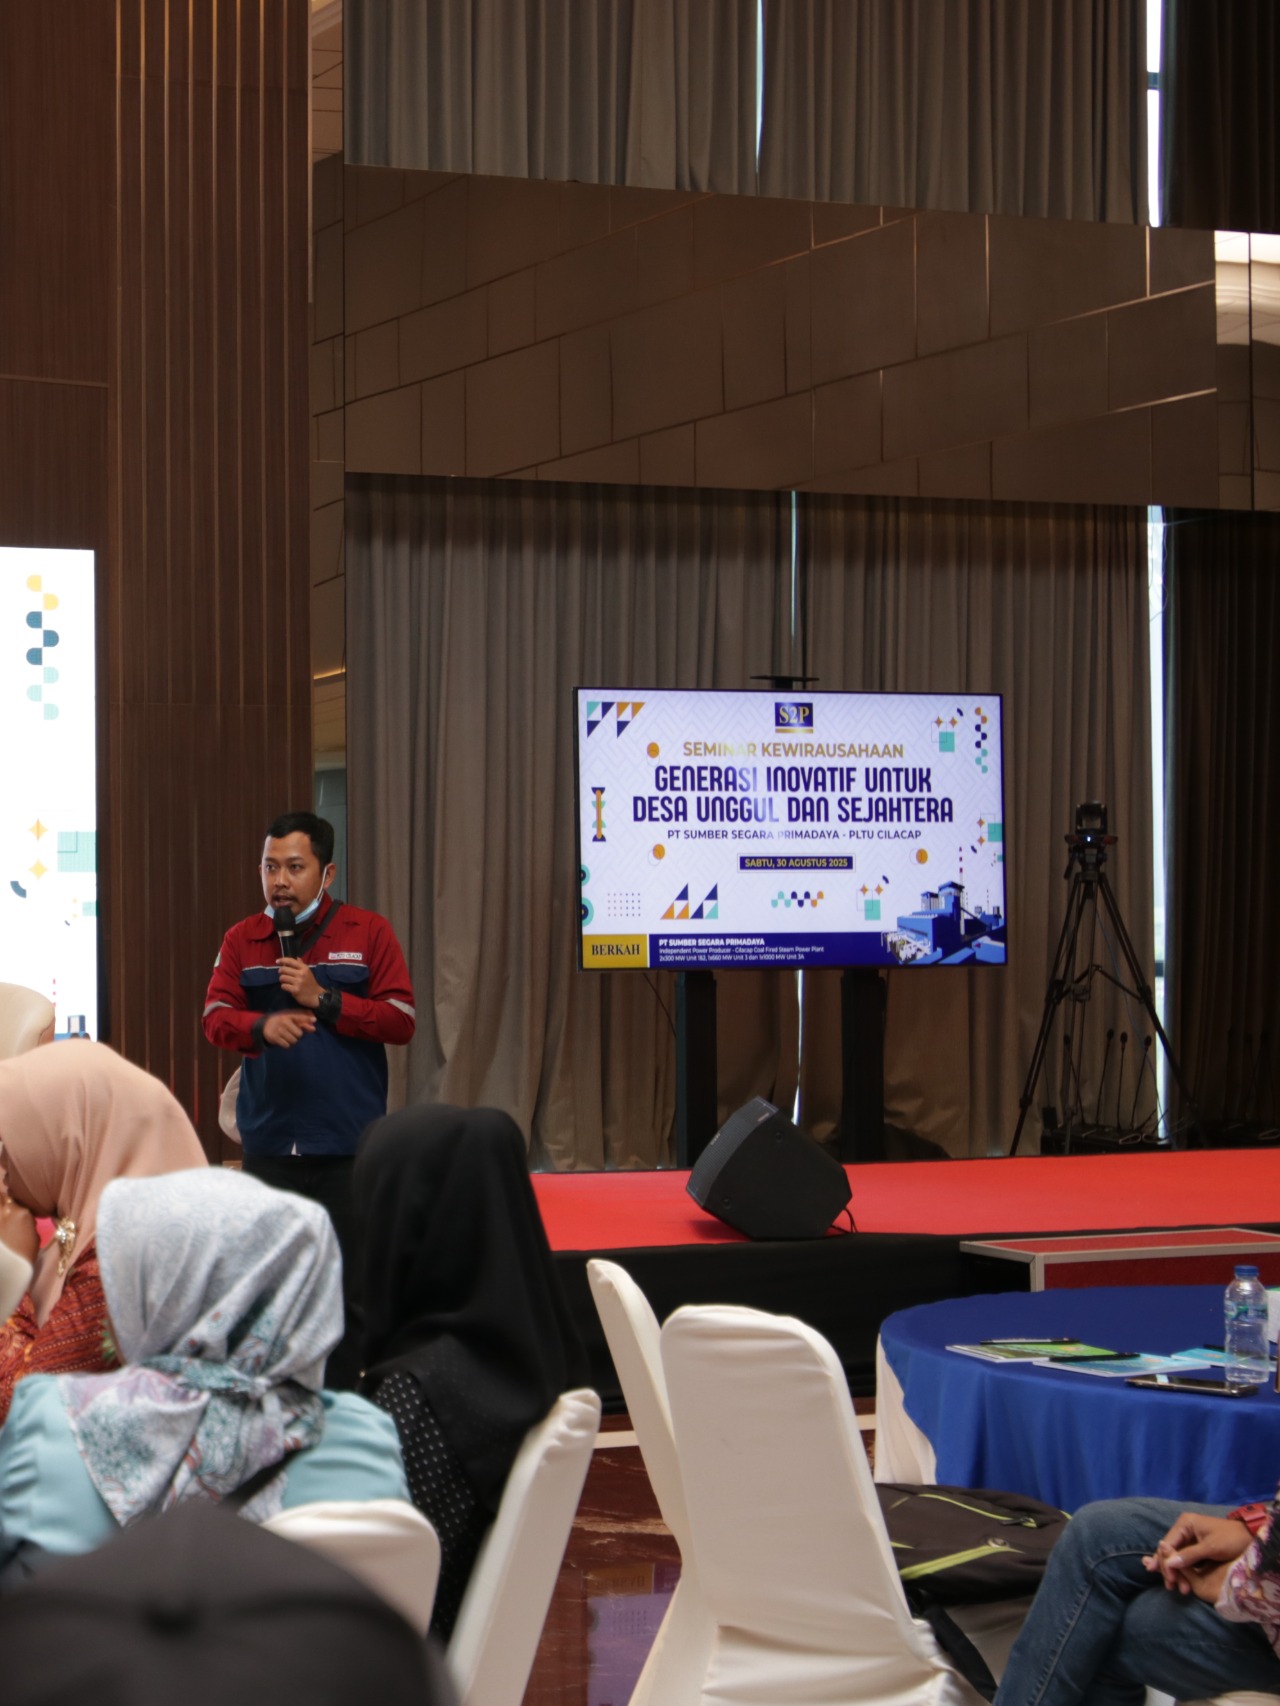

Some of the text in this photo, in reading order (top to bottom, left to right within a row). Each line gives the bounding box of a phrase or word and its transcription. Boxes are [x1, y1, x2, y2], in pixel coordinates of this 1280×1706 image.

[779, 706, 810, 724] S2P
[683, 741, 905, 758] SEMINAR KEWIRAUSAHAAN
[654, 765, 933, 793] GENERASI INOVATIF UNTUK
[632, 796, 954, 823] DESA UNGGUL DAN SEJAHTERA
[667, 829, 681, 840] PT
[683, 829, 729, 840] SUMBER
[730, 829, 775, 840] SEGARA
[777, 829, 841, 840] PRIMADAYA
[848, 829, 875, 840] PLTU
[876, 829, 922, 840] CILACAP
[744, 858, 848, 869] SABTU, 30 AGUSTUS 2025
[591, 944, 641, 956] BERKAH
